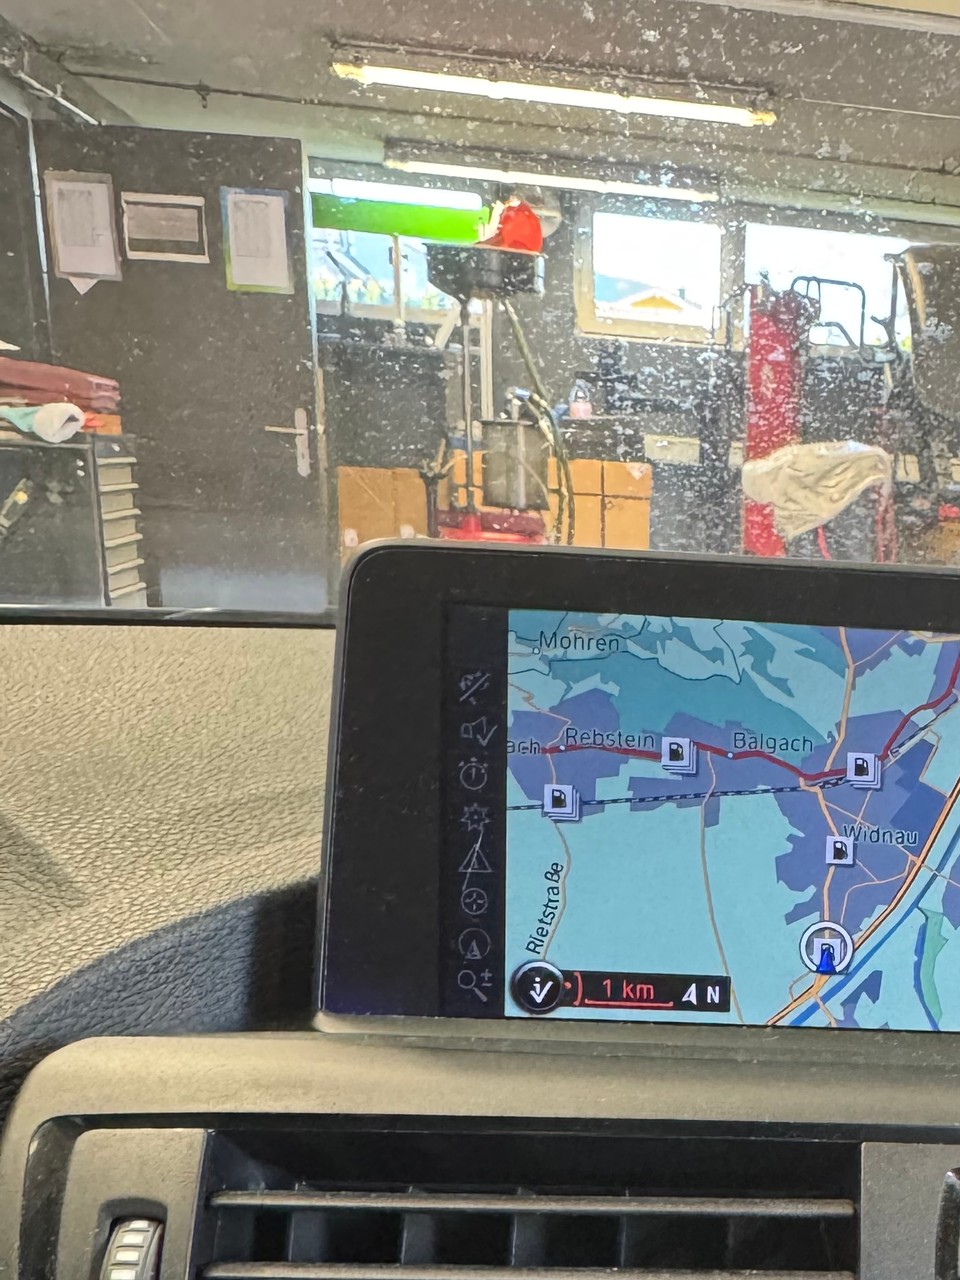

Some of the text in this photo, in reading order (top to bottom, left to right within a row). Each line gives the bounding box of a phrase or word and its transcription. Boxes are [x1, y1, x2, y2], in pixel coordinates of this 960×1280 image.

[539, 631, 619, 651] Mohren
[566, 727, 655, 749] Rebstein
[734, 732, 813, 753] Balgach
[843, 824, 918, 845] Widnau
[602, 978, 654, 999] 1 km
[706, 985, 720, 1004] N
